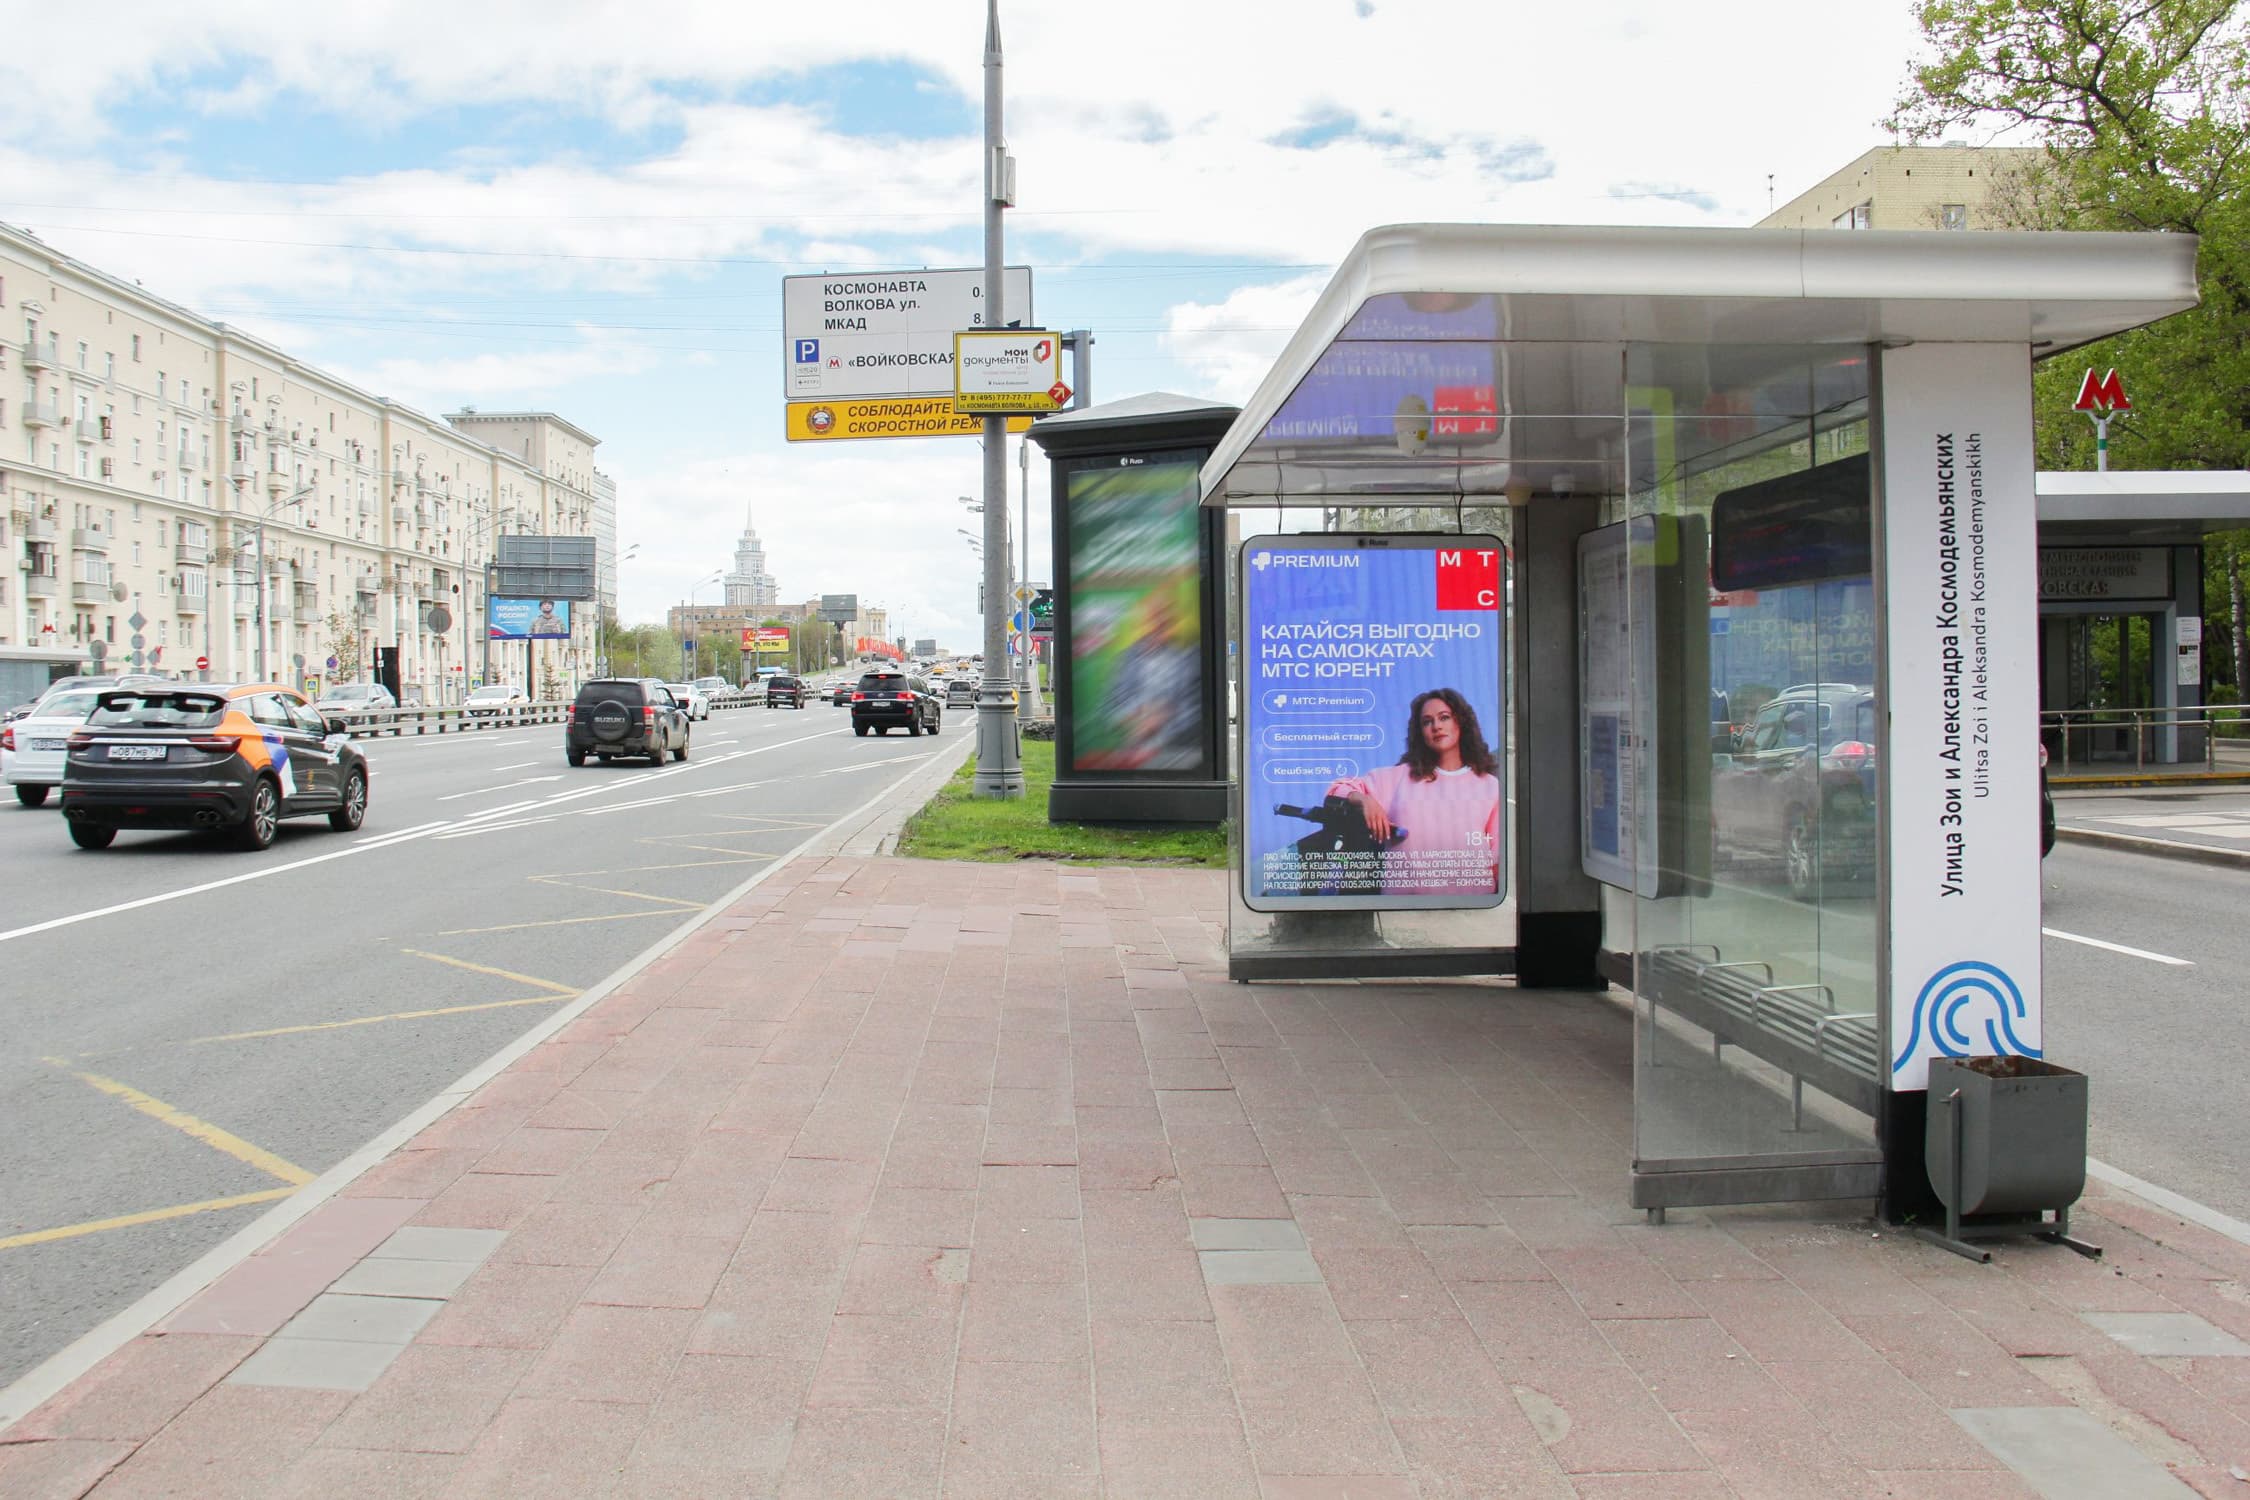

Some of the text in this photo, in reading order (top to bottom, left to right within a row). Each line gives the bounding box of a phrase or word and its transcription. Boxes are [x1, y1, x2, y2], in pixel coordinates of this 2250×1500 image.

[824, 280, 928, 296] КОСМОНАВТА
[824, 298, 921, 312] ВОЛКОВА ул.
[824, 317, 867, 331] МКАД
[963, 355, 1029, 367] документы
[848, 401, 952, 417] СОБЛЮДАЙТЕ
[848, 417, 947, 433] СКОРОСТНОЙ
[1965, 432, 1985, 601] Kosmodemyanskikh
[1273, 555, 1359, 568] PREMIUM
[1261, 620, 1481, 641] КАТАЙСЯ ВЫГОДНО
[1261, 642, 1435, 659] НА САМОКАТАХ
[1971, 607, 1988, 701] Aleksandra
[1262, 661, 1396, 678] МТС ЮРЕНТ
[1935, 432, 1965, 897] Улица Зои и Александра Космодемьянских
[1292, 696, 1364, 705] МТС Premium
[1274, 732, 1373, 742] Бесплатный старт
[1972, 716, 1988, 745] Zoi
[1273, 766, 1332, 776] Кешбэк 5%
[1973, 750, 1989, 798] Ulitsa
[1465, 831, 1494, 846] 18+
